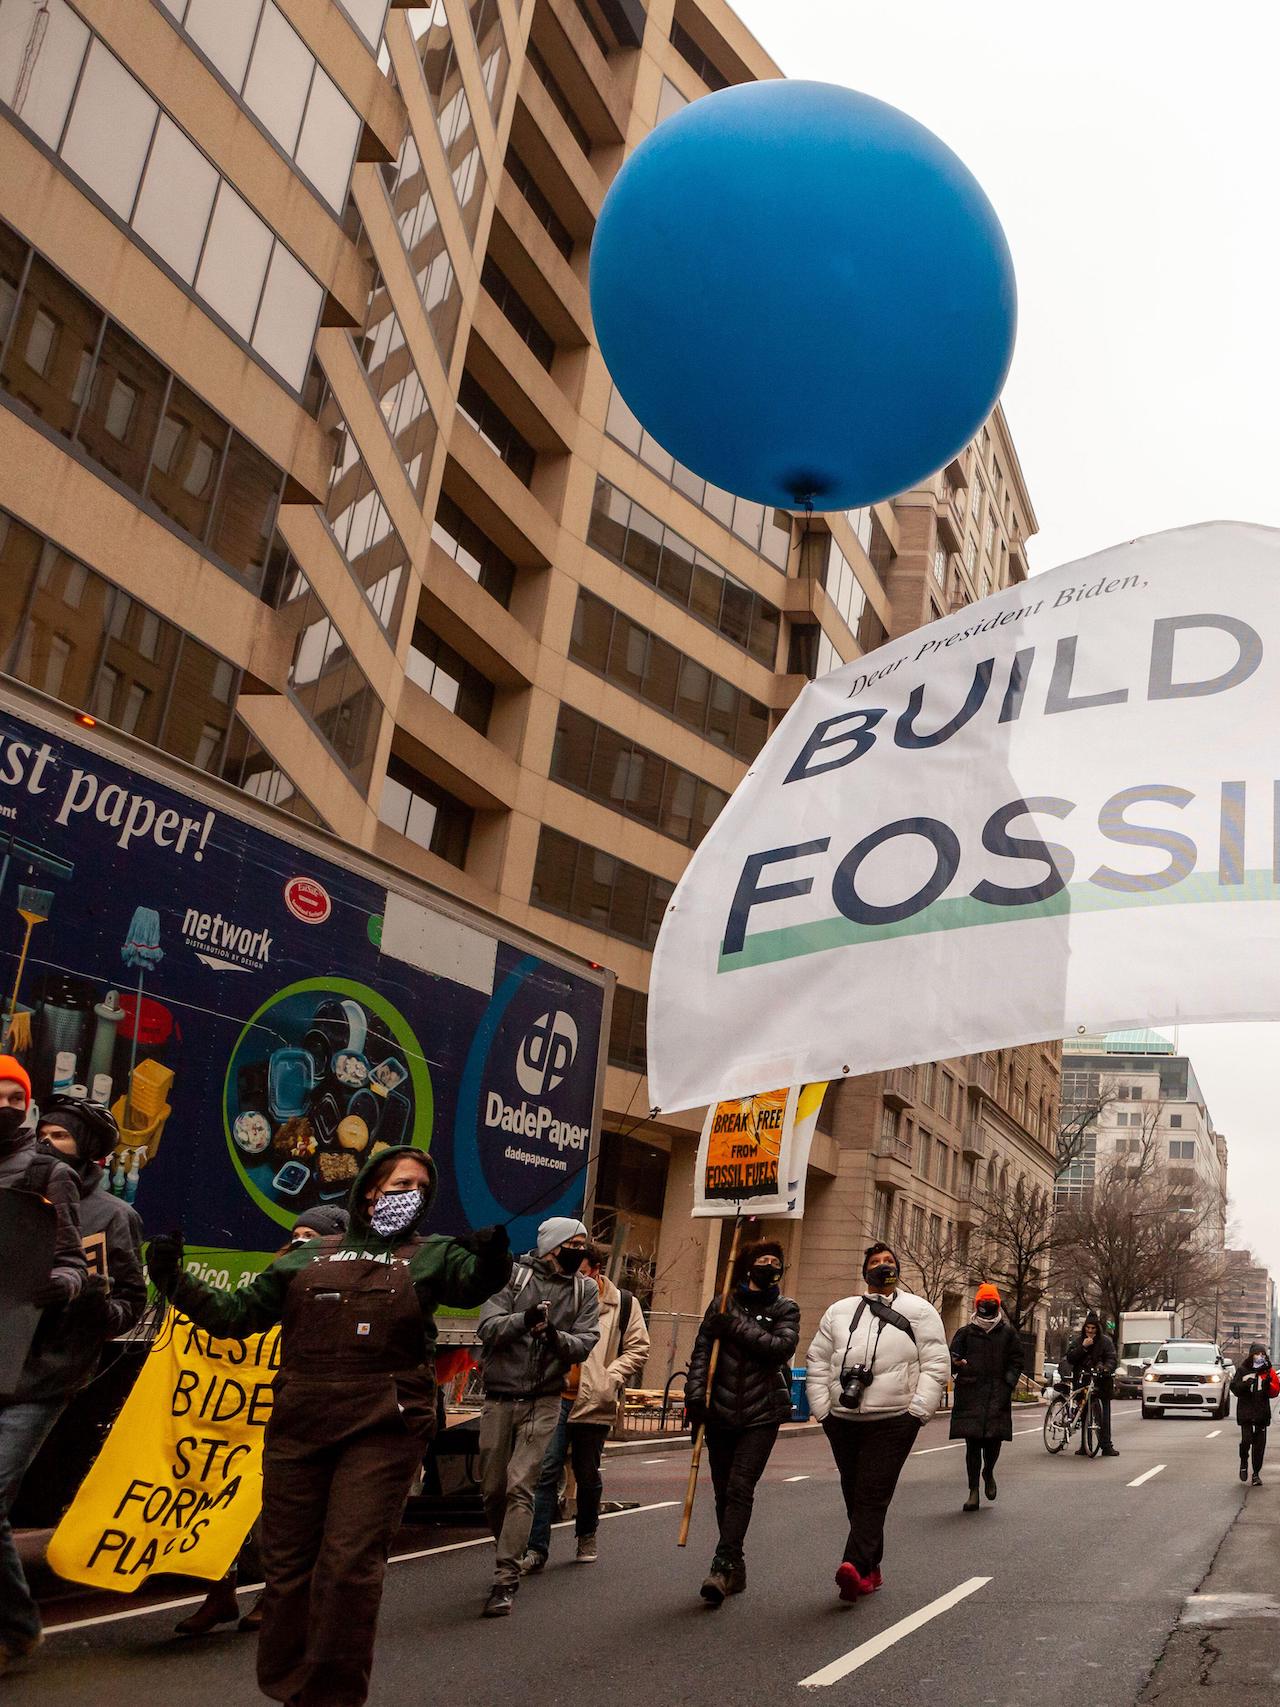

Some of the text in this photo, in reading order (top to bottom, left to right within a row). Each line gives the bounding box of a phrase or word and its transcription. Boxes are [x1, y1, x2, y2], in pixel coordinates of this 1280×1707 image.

[846, 573, 1149, 699] Dear President Biden,
[782, 613, 1263, 785] BUILD
[0, 735, 215, 862] st paper!
[182, 908, 273, 962] network
[485, 1091, 589, 1151] DadePaper
[714, 1108, 783, 1133] BREAK FREE
[505, 1146, 567, 1171] dadepaper.com
[707, 1160, 777, 1188] FOSSIL FUELS
[731, 1144, 758, 1158] FROM
